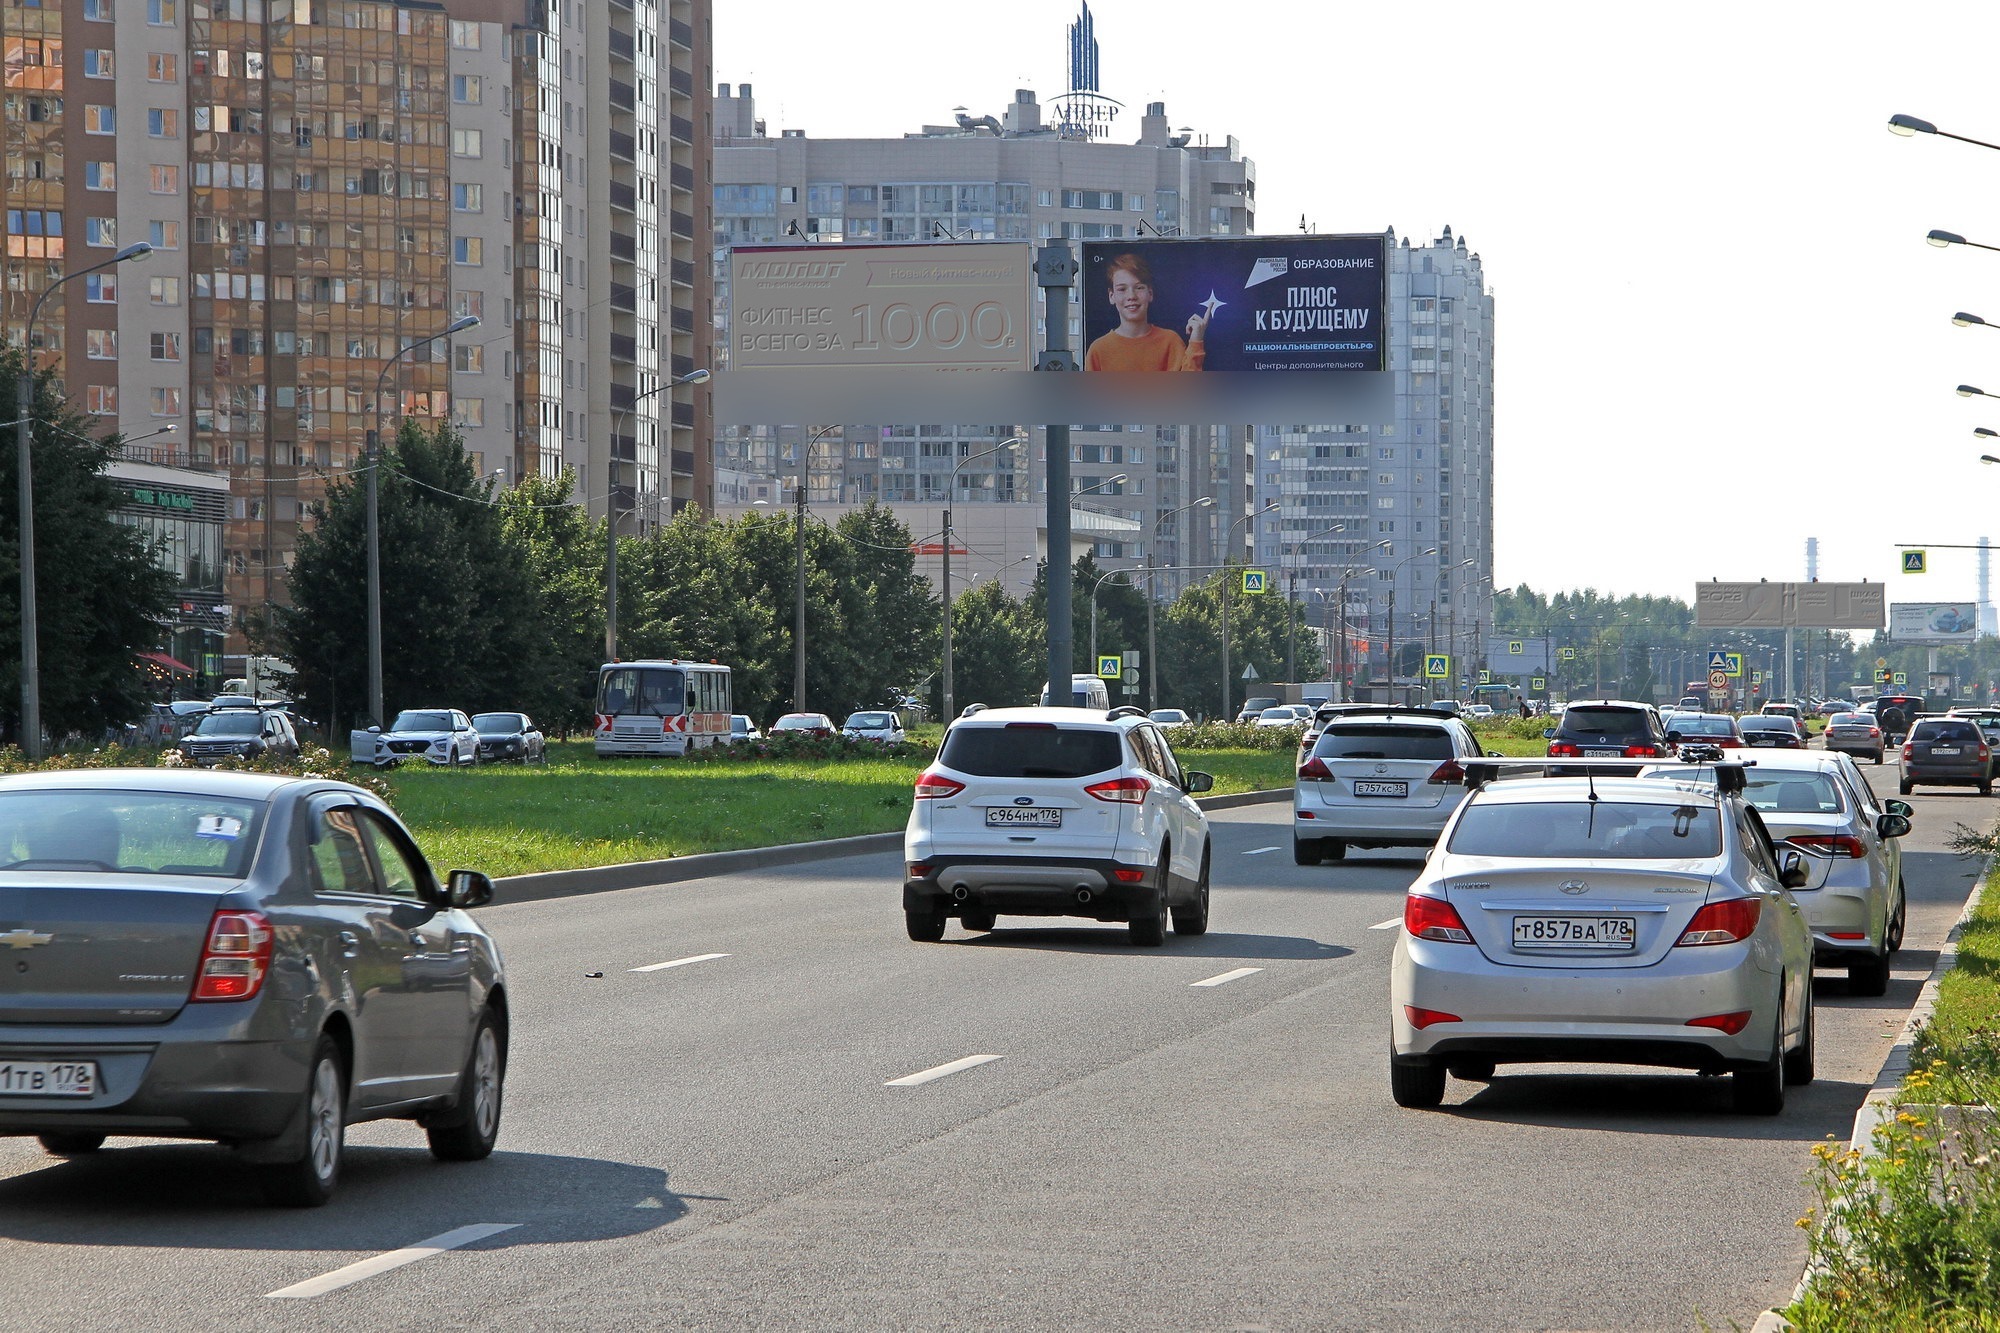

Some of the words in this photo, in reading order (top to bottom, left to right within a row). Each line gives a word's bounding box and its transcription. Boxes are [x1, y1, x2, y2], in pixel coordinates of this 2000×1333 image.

[741, 261, 847, 279] МОЛОТ
[889, 266, 929, 279] Новый
[1293, 258, 1374, 269] ОБРАЗОВАНИЕ
[1287, 286, 1337, 308] ПЛЮС
[741, 306, 833, 326] ФИТНЕС
[1255, 310, 1267, 331] К
[1271, 308, 1369, 332] БУДУЩЕМУ
[851, 301, 1012, 351] 1000
[741, 333, 812, 351] ВСЕГО
[816, 332, 846, 351] ЗА
[1245, 342, 1373, 352] НАЦИОНАЛЬНЫЕПРОЕКТЫ.РФ
[1255, 362, 1288, 371] Центры
[1289, 361, 1364, 370] дополнительного
[1712, 675, 1724, 684] 40
[1358, 784, 1392, 793] Е757КС
[1394, 784, 1404, 792] 35
[989, 809, 1038, 822] С964НМ
[1040, 809, 1056, 819] 178
[1521, 920, 1596, 940] Т857ВА
[1600, 920, 1628, 935] 178
[51, 1064, 88, 1084] 178
